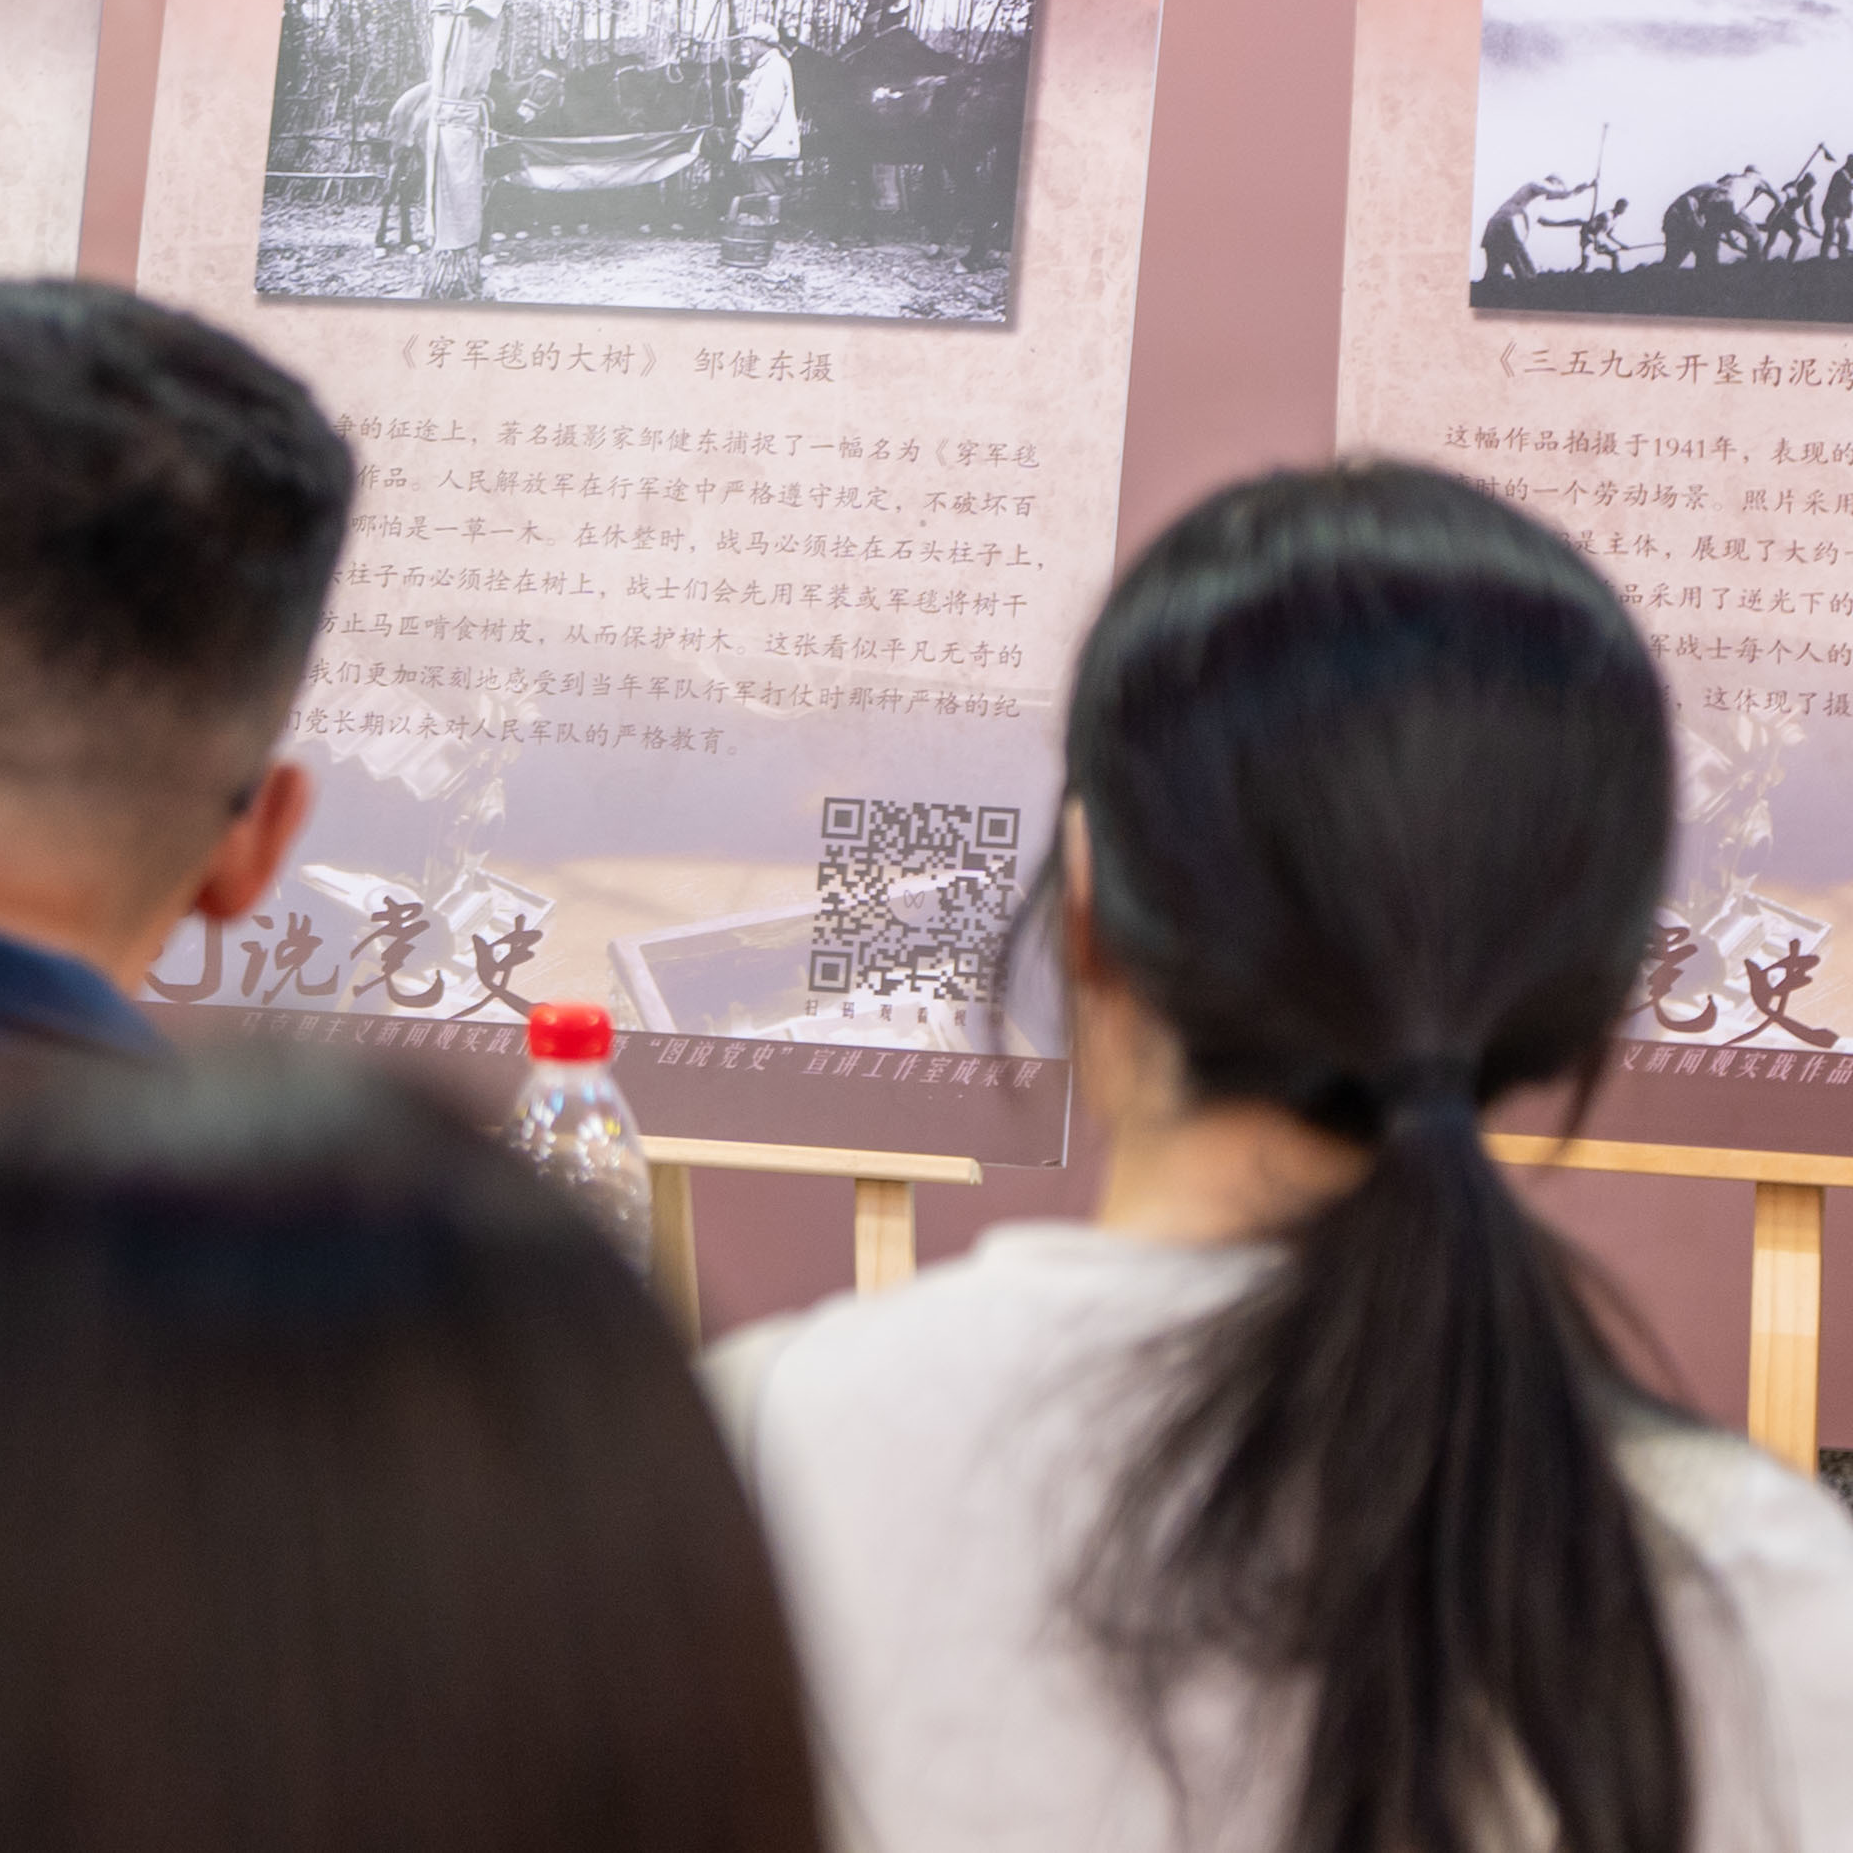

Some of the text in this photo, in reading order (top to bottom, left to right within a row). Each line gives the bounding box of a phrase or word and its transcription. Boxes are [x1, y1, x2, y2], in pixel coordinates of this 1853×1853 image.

[403, 333, 836, 383] 《穿军毯的大树》 邹健东摄
[1500, 341, 1853, 391] 《三五九旅开垦南泥湾
[1444, 424, 1853, 466] 这幅作品拍摄于1941年，表现的
[1560, 530, 1853, 566] 是主体，展现了大约
[1604, 579, 1853, 617] 品采用了逆光下的
[1664, 685, 1853, 718] ，这体现了摄
